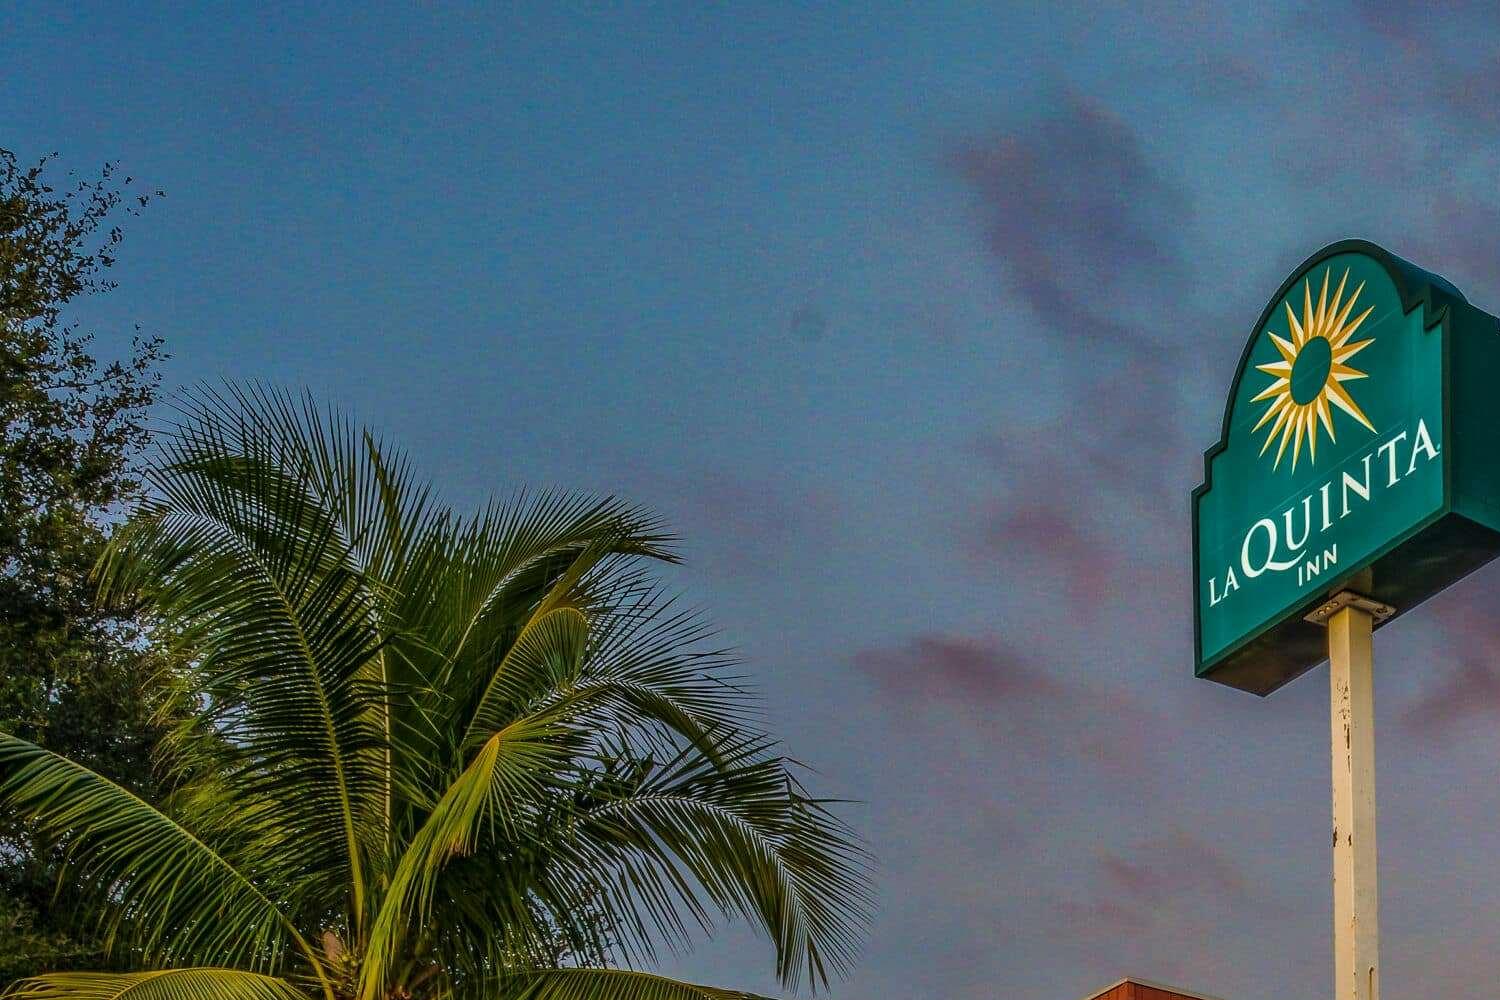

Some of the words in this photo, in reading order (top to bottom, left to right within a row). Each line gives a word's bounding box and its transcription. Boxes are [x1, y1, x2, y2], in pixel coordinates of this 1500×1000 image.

[1208, 566, 1241, 607] LA
[1240, 418, 1438, 579] QUINTA
[1298, 544, 1338, 586] INN
